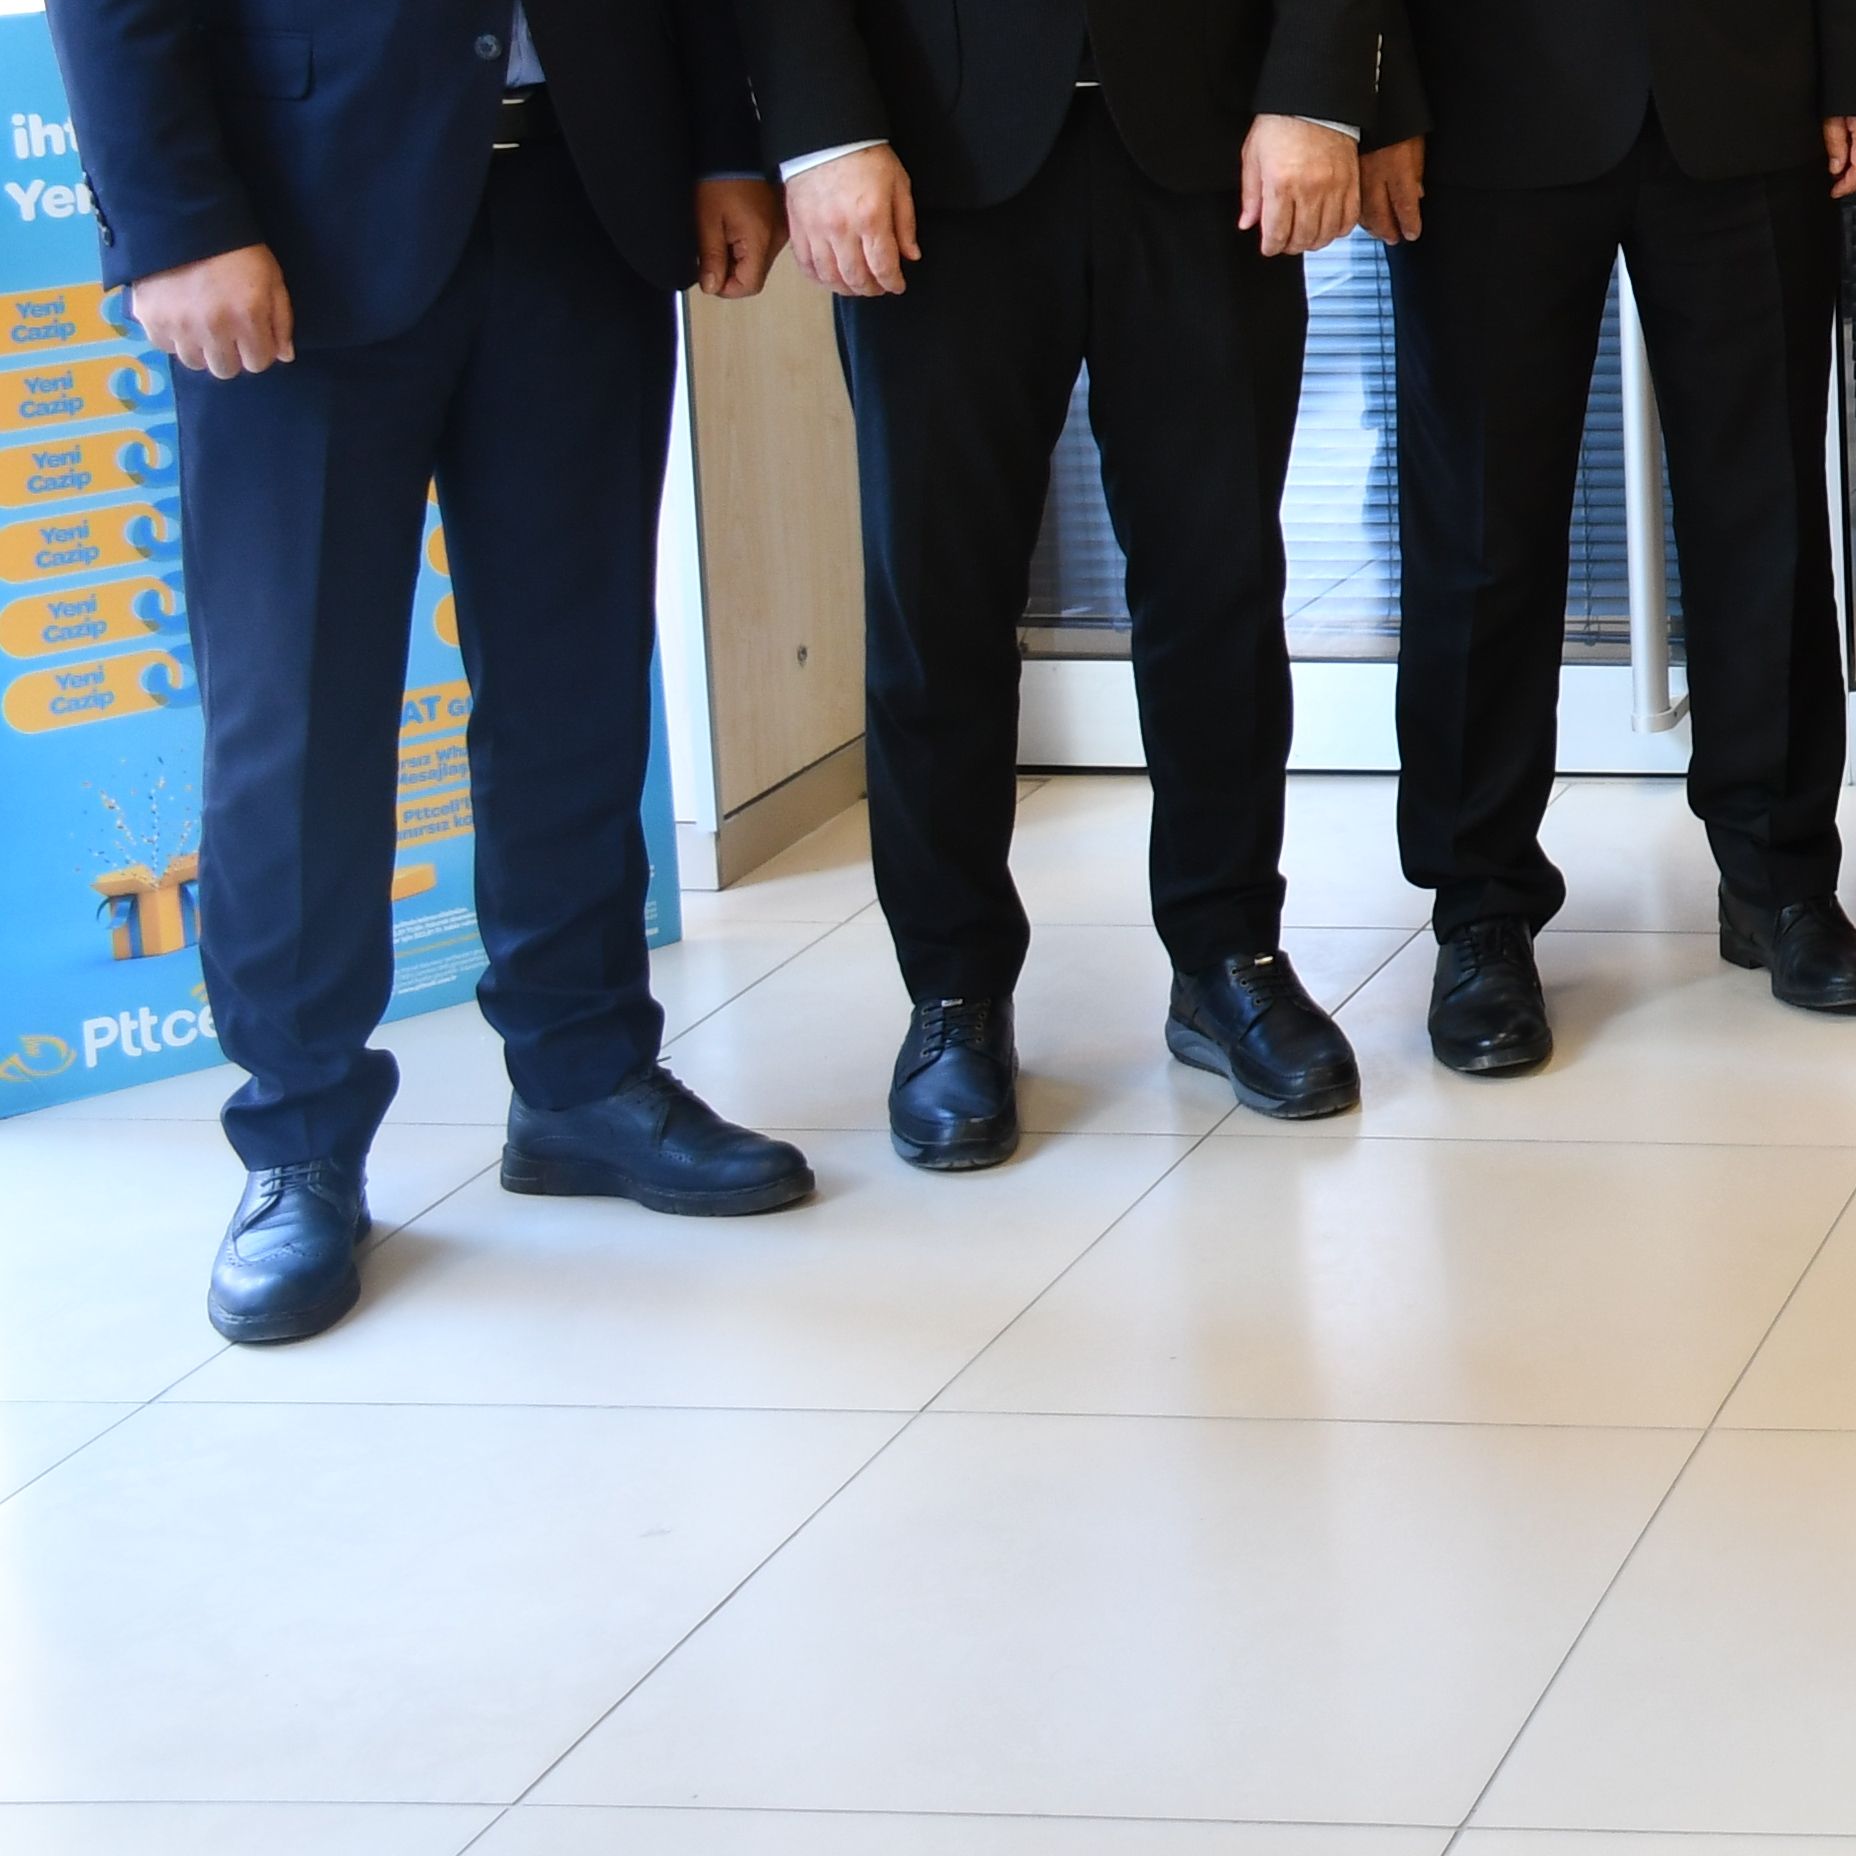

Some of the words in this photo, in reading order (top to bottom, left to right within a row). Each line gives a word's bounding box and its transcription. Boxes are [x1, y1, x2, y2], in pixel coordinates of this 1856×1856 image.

[16, 296, 65, 319] Yeni
[11, 319, 76, 345] Cazip
[24, 370, 74, 394] Yeni
[18, 394, 84, 420] Cazip
[32, 445, 82, 470] Yeni
[26, 469, 92, 495] Cazip
[40, 519, 90, 545] Yeni
[35, 544, 100, 569] Cazip
[47, 594, 97, 619] Yeni
[42, 617, 107, 643] Cazip
[55, 664, 105, 691] Yeni
[49, 689, 115, 716] Cazip
[83, 1006, 218, 1069] Pttce
